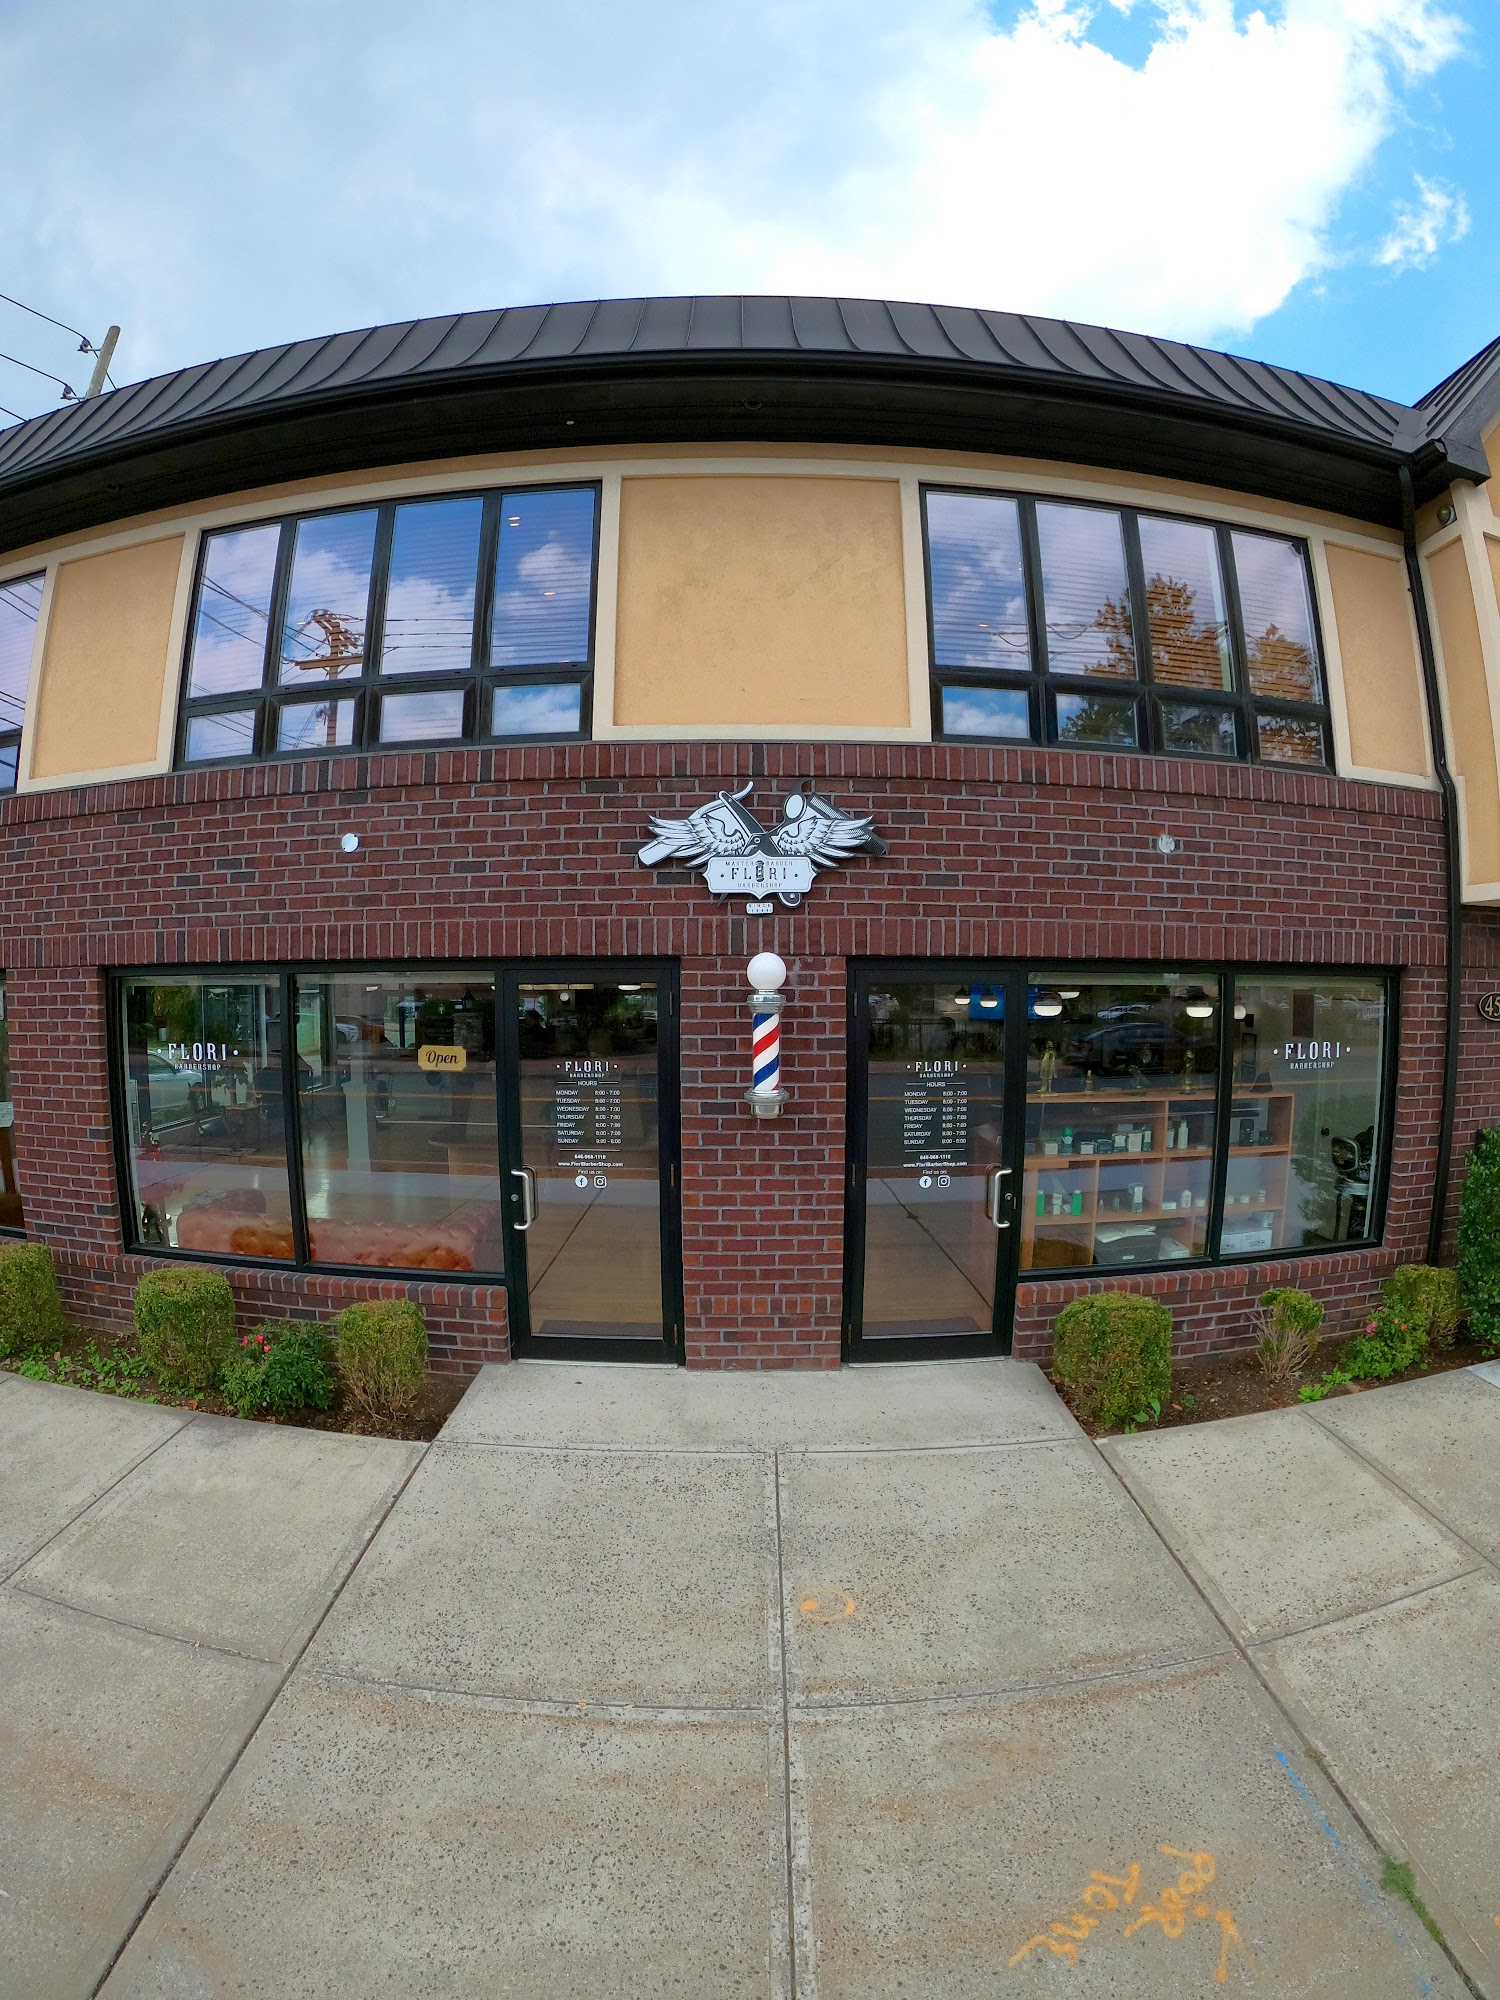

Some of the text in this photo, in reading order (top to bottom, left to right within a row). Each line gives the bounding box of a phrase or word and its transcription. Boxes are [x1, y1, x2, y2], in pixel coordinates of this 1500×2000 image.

[168, 1042, 226, 1061] FLORI
[1285, 1041, 1340, 1060] FLORI
[425, 1049, 459, 1068] Open
[174, 1063, 221, 1071] BARBERSHOP
[565, 1061, 609, 1072] FLORI
[915, 1061, 959, 1072] FLORI
[1290, 1061, 1334, 1070] BARBERSHOP
